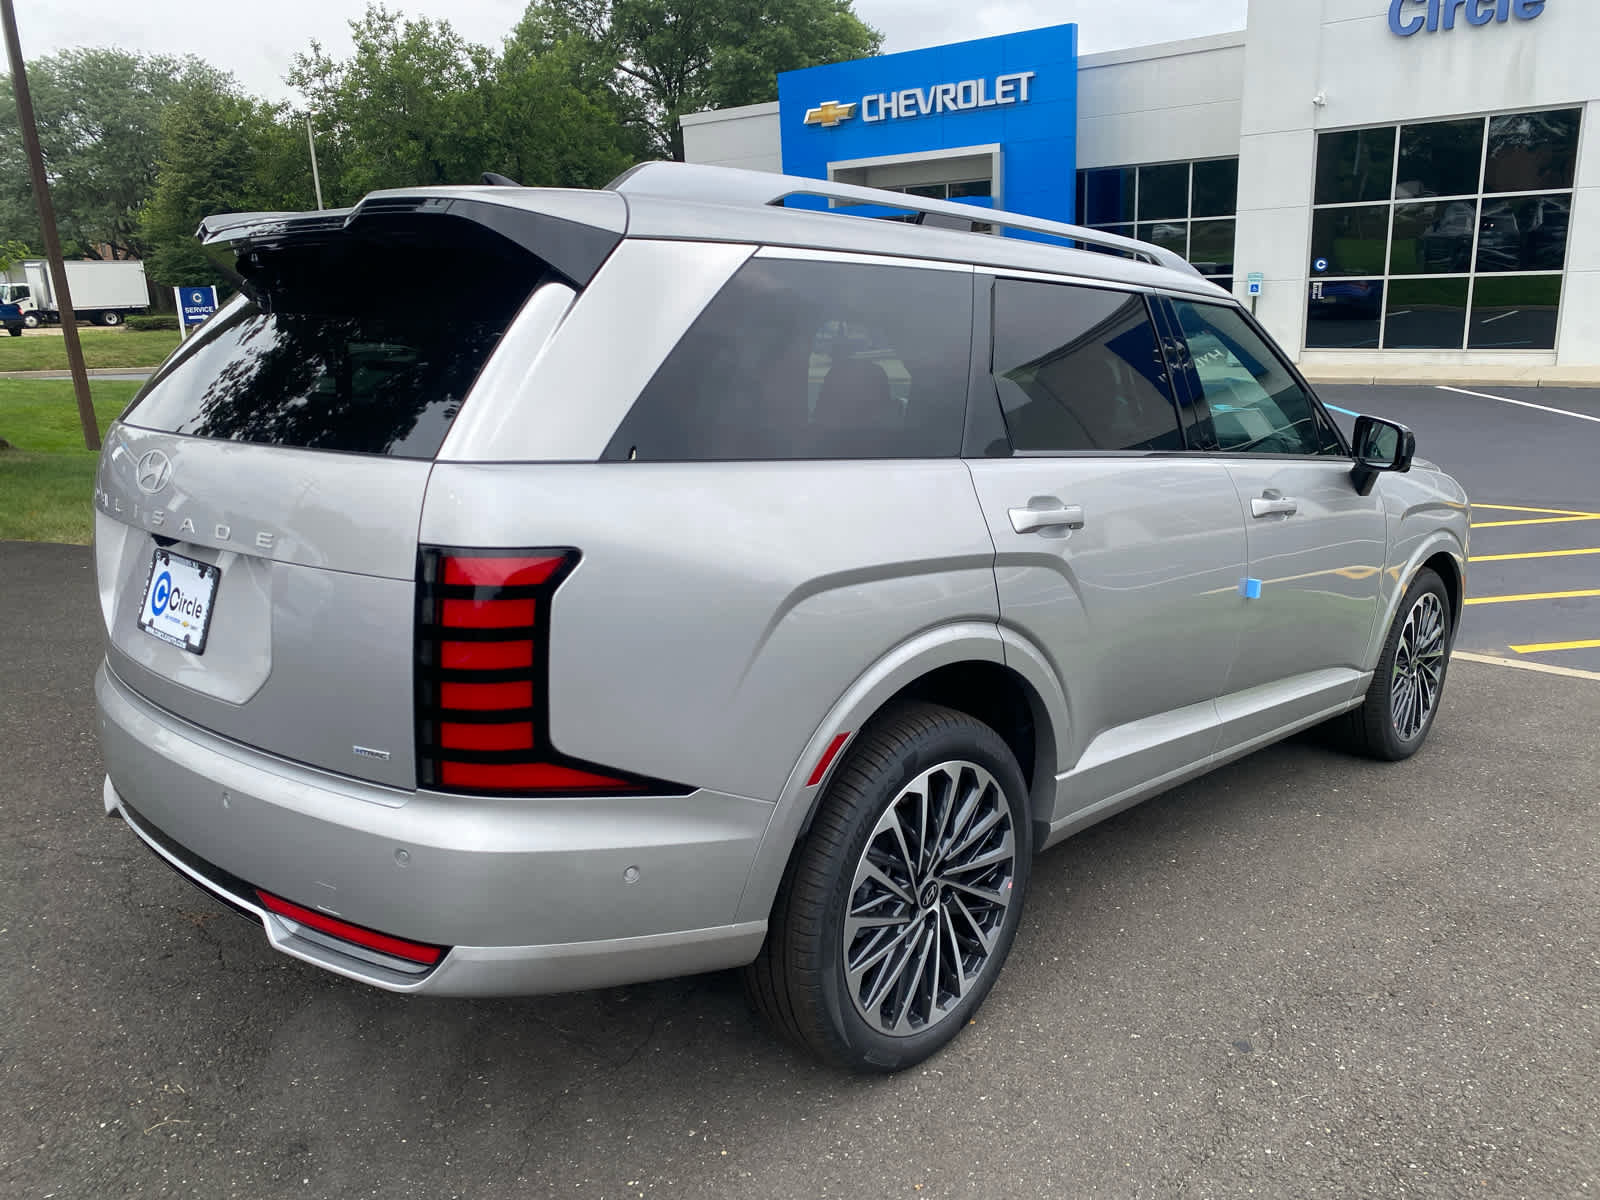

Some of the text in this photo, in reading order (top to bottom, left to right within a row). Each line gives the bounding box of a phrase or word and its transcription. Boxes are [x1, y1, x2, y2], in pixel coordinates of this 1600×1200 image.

[862, 71, 1035, 122] CHEVROLET
[184, 305, 214, 313] SERVICE
[169, 586, 203, 619] Circle
